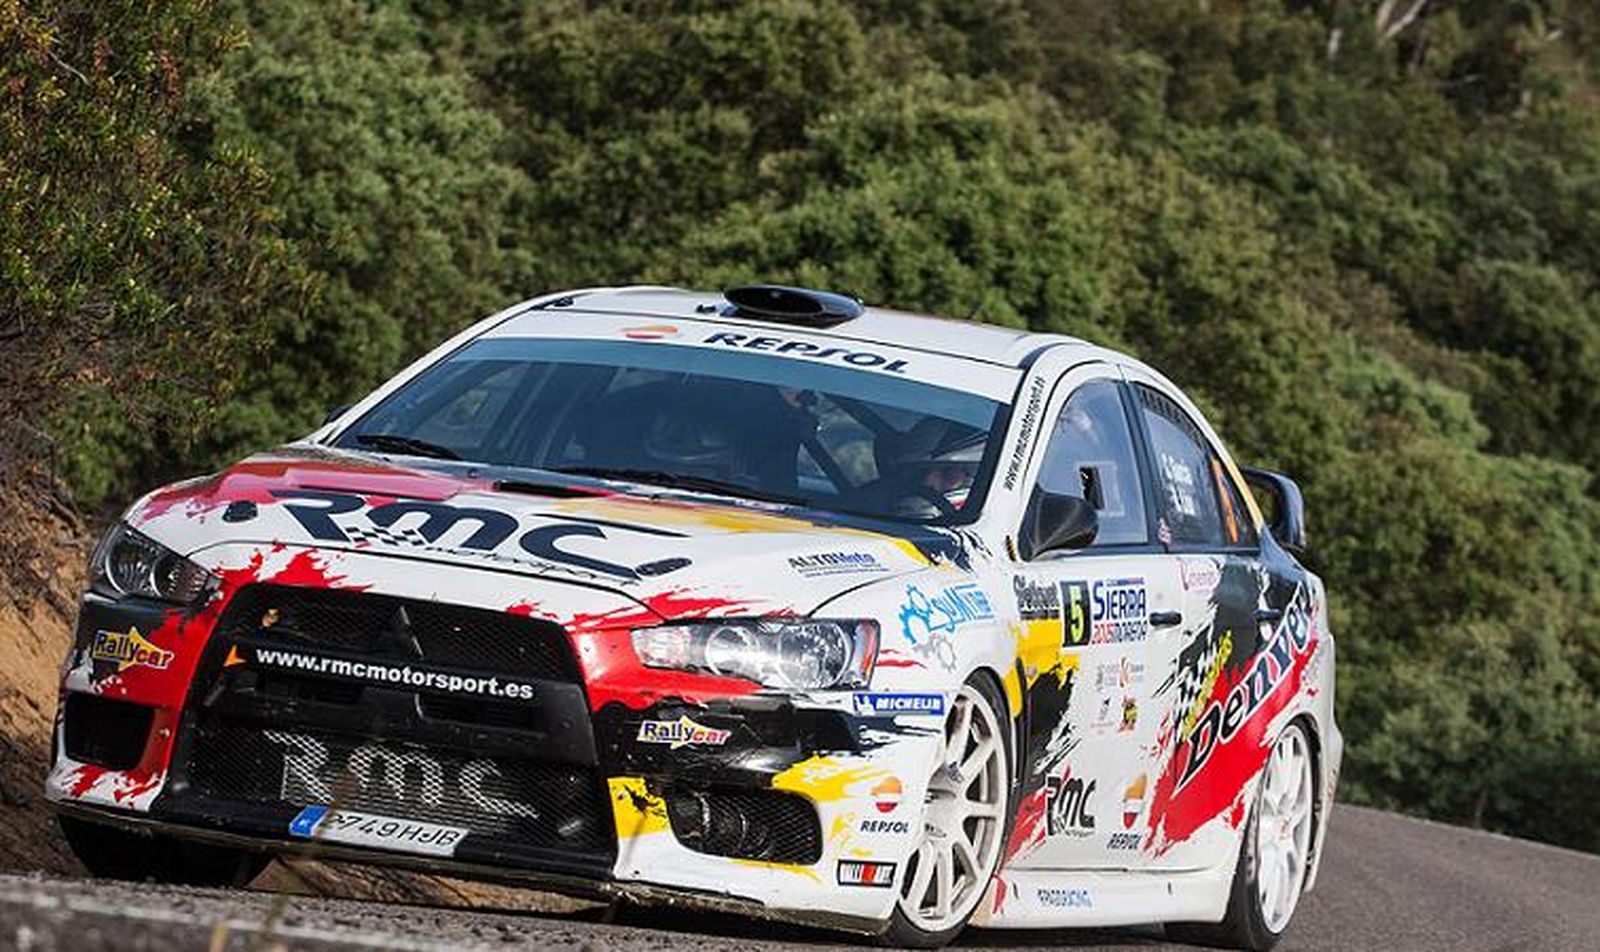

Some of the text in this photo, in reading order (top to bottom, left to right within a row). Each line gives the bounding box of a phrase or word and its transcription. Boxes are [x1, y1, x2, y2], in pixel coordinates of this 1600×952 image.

[704, 332, 910, 374] REPSOL
[1069, 584, 1084, 643] 5
[95, 630, 173, 668] Rallycar
[256, 647, 534, 700] www.rmcmotorsport.es
[1177, 582, 1312, 791] Denver
[876, 697, 941, 710] MICHELIN
[643, 722, 730, 743] Rallycar
[860, 820, 910, 834] REPSOL
